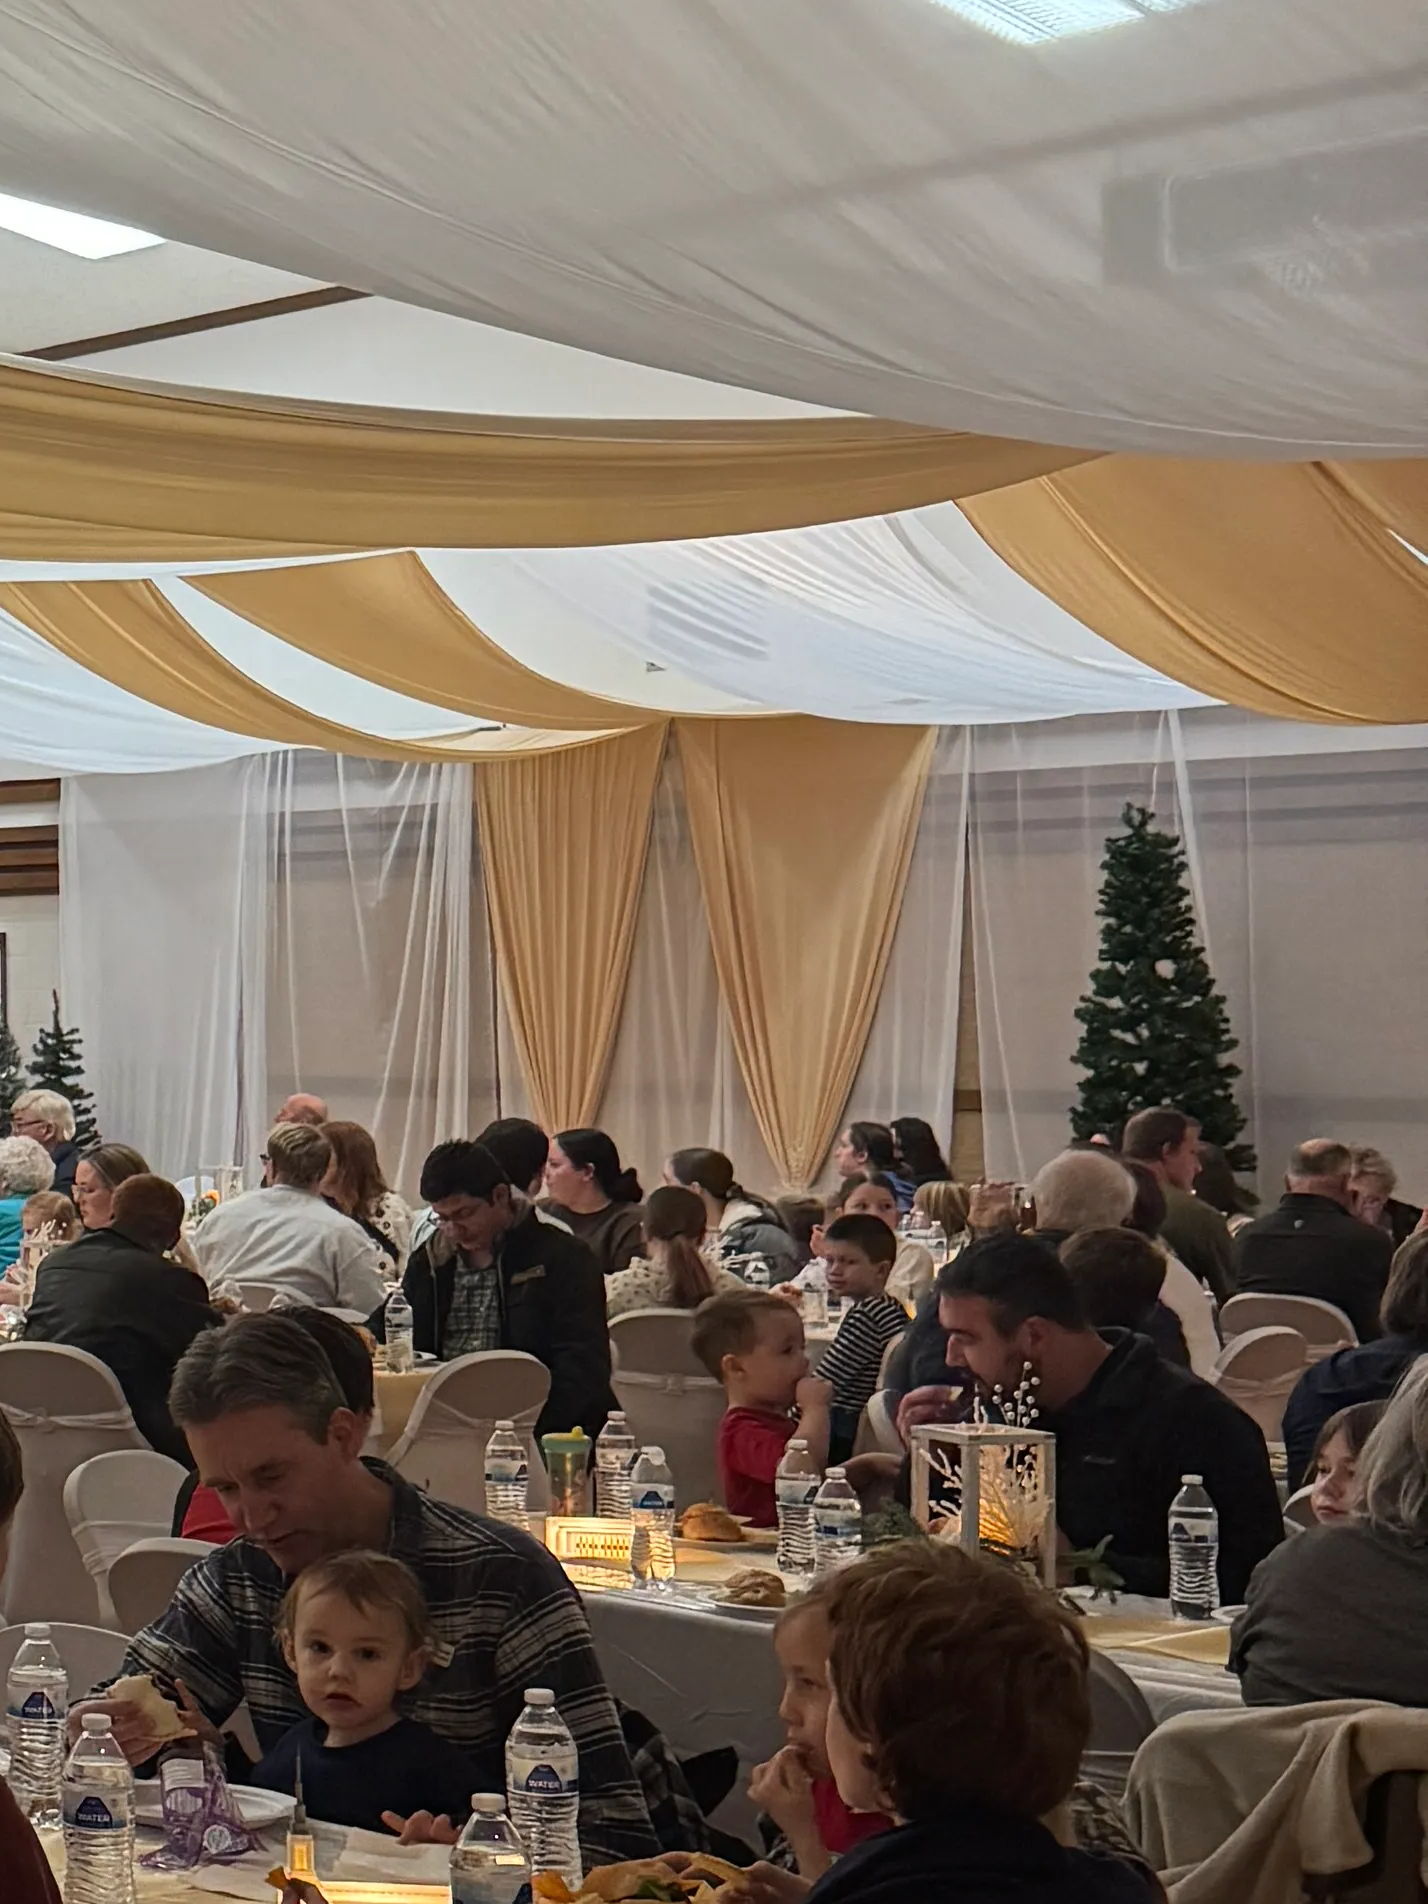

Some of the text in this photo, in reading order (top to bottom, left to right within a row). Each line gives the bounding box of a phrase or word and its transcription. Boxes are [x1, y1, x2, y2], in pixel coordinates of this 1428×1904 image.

[24, 1706, 52, 1714] WATR
[528, 1779, 560, 1789] WATER
[78, 1813, 111, 1823] WATER
